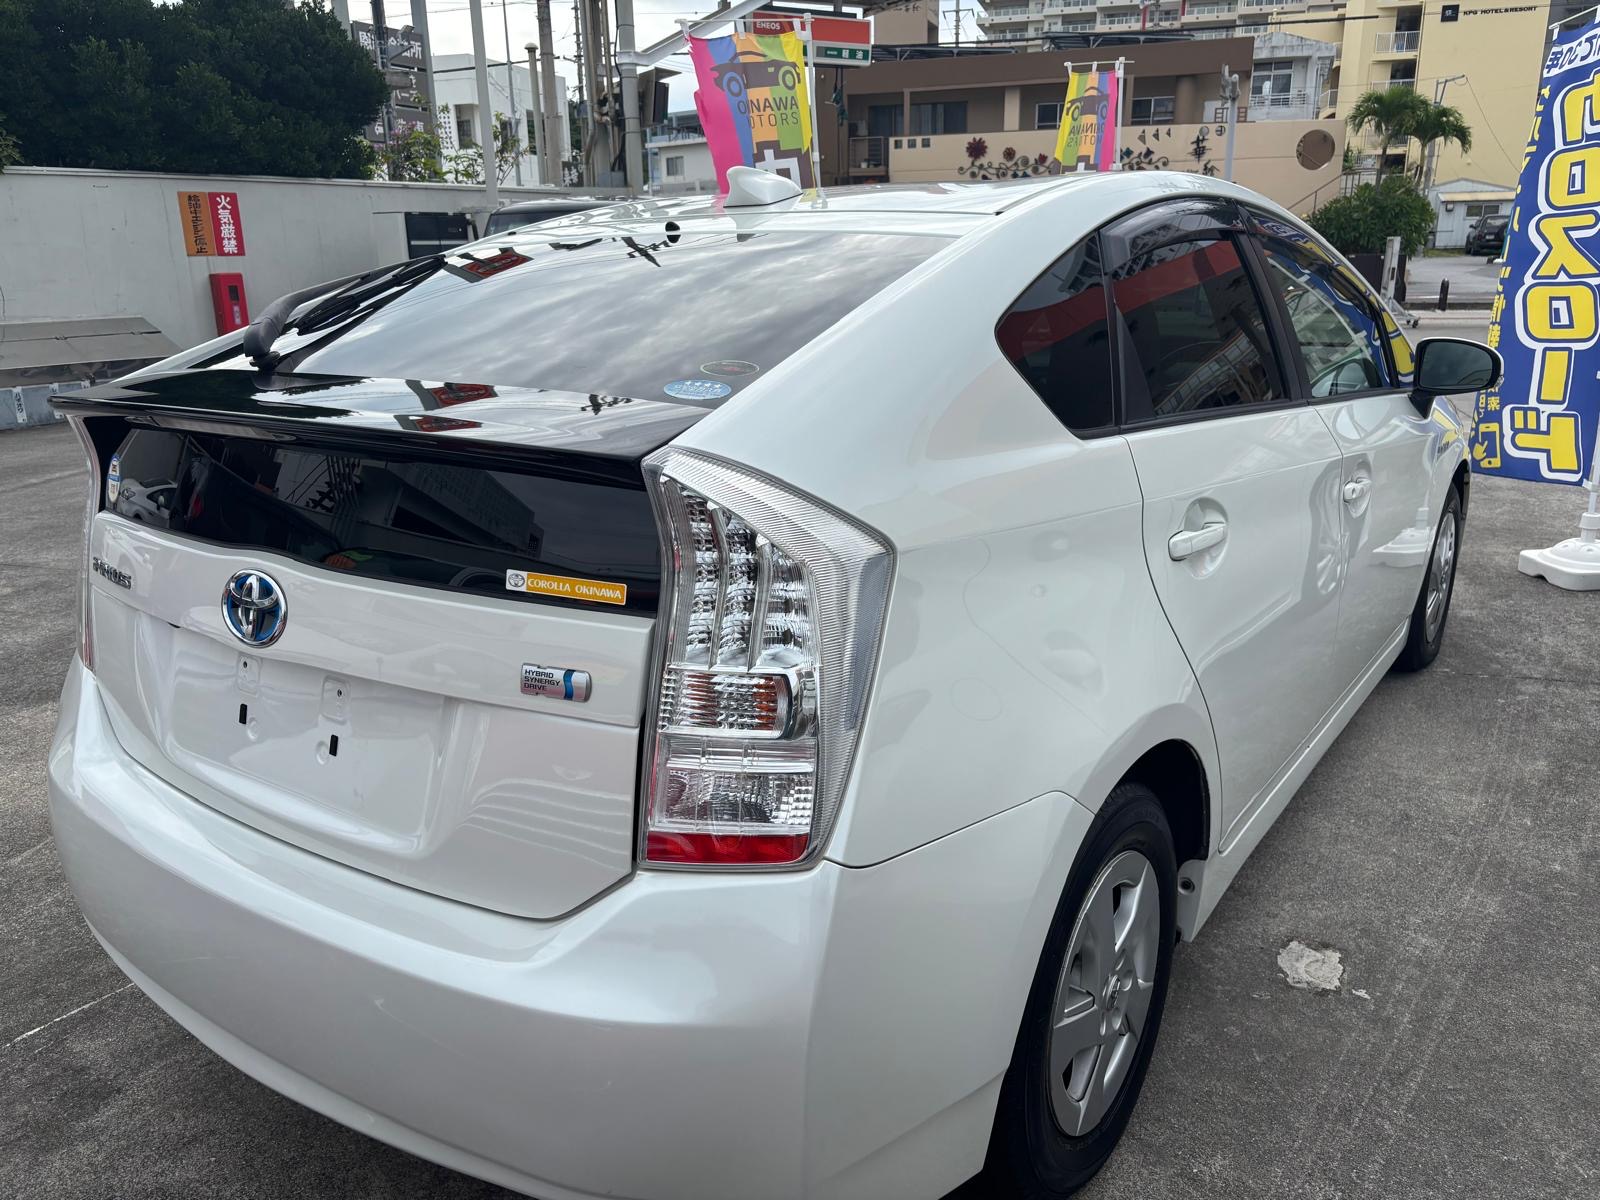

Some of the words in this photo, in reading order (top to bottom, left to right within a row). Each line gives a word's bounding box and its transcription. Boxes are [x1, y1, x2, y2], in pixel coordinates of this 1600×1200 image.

[756, 21, 781, 30] ENEOS
[216, 194, 239, 254] 火気厳禁
[528, 578, 571, 592] COROLLA
[575, 584, 622, 599] OKINAWA
[524, 669, 554, 679] HYBRID
[523, 676, 561, 687] SYNERGY
[523, 682, 547, 692] DRIVE
